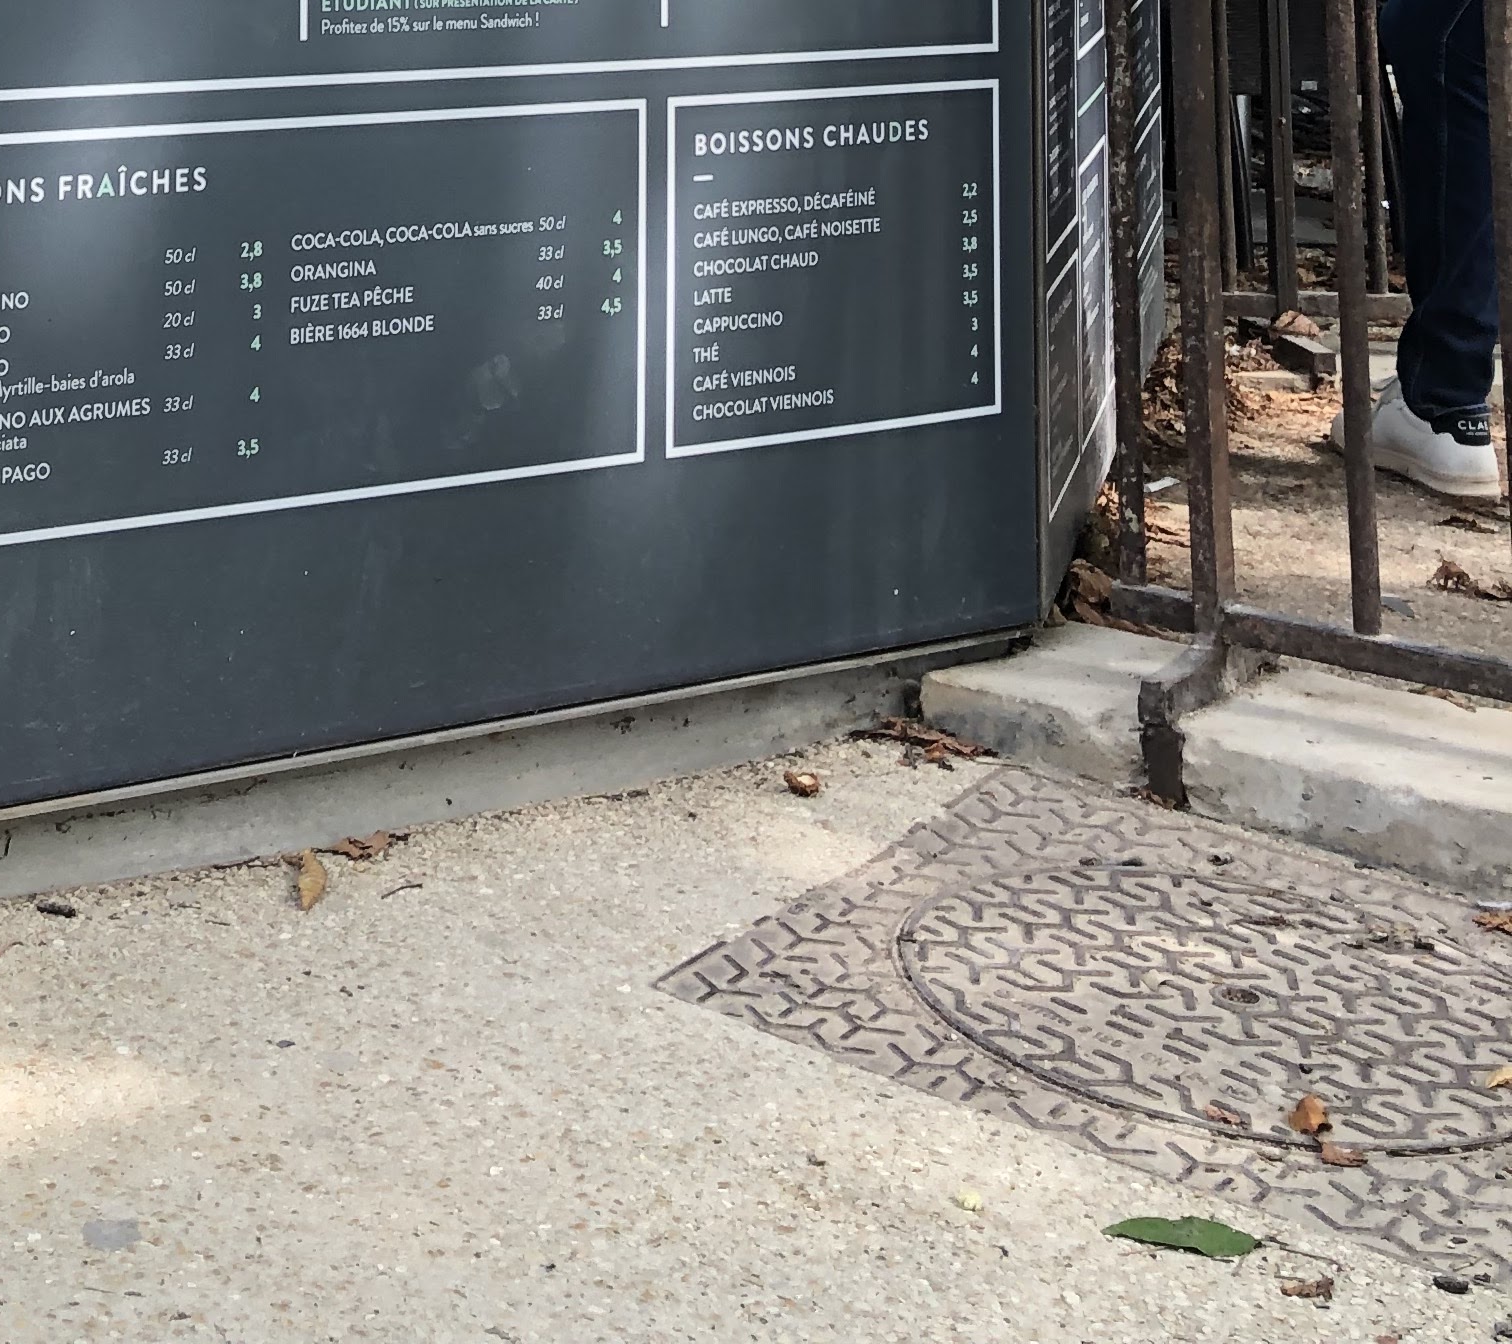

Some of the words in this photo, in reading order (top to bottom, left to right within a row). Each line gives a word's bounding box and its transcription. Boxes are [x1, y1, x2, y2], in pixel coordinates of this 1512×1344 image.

[321, 18, 368, 35] Profitez
[369, 17, 385, 34] de
[387, 16, 411, 33] 15%
[412, 20, 431, 32] sur
[432, 15, 444, 31] le
[445, 19, 478, 30] menu
[479, 11, 533, 29] Sandwich
[694, 126, 815, 157] BOISSONS
[822, 118, 929, 148] CHAUDES
[58, 164, 207, 201] FRAÎCHES
[693, 198, 730, 220] CAFÉ
[731, 196, 802, 217] EXPRESSO,
[803, 186, 876, 211] DÉCAFÉINÉ
[962, 182, 978, 200] 2,2
[290, 228, 385, 251] COCA-COLA,
[385, 221, 473, 244] COCA-COLA
[473, 223, 498, 237] sans
[498, 221, 534, 235] sucres
[612, 209, 623, 225] 4
[693, 226, 730, 249] CAFÉ
[731, 225, 783, 246] LUNGO,
[784, 218, 819, 241] CAFÉ
[820, 217, 881, 237] NOISETTE
[962, 208, 978, 227] 2,5
[240, 240, 263, 262] 2,8
[290, 259, 377, 282] ORANGINA
[602, 238, 623, 259] 3,5
[693, 254, 769, 278] CHOCOLAT
[770, 250, 819, 270] CHAUD
[961, 235, 978, 254] 3,8
[239, 272, 263, 293] 3,8
[290, 293, 330, 314] FUZE
[331, 291, 361, 310] TEA
[363, 285, 414, 307] PÊCHE
[612, 267, 622, 283] 4
[693, 286, 733, 307] LATTE
[962, 262, 979, 281] 3,5
[252, 303, 262, 320] 3
[290, 322, 335, 345] BIÈRE
[337, 321, 369, 340] 1664
[372, 314, 435, 337] BLONDE
[600, 297, 622, 317] 4,5
[693, 310, 784, 335] CAPPUCCINO
[962, 289, 979, 308] 3,5
[250, 334, 262, 352] 4
[692, 341, 720, 364] THÉ
[971, 316, 979, 332] 3
[692, 368, 729, 392] CAFÉ
[730, 365, 796, 388] VIENNOIS
[970, 343, 979, 358] 4
[28, 406, 65, 428] AUX
[67, 397, 151, 423] AGRUMES
[249, 386, 261, 403] 4
[692, 396, 769, 421] CHOCOLAT
[769, 388, 835, 412] VIENNOIS
[970, 370, 979, 385] 4
[1, 462, 51, 485] PAGO
[237, 438, 260, 459] 3,5
